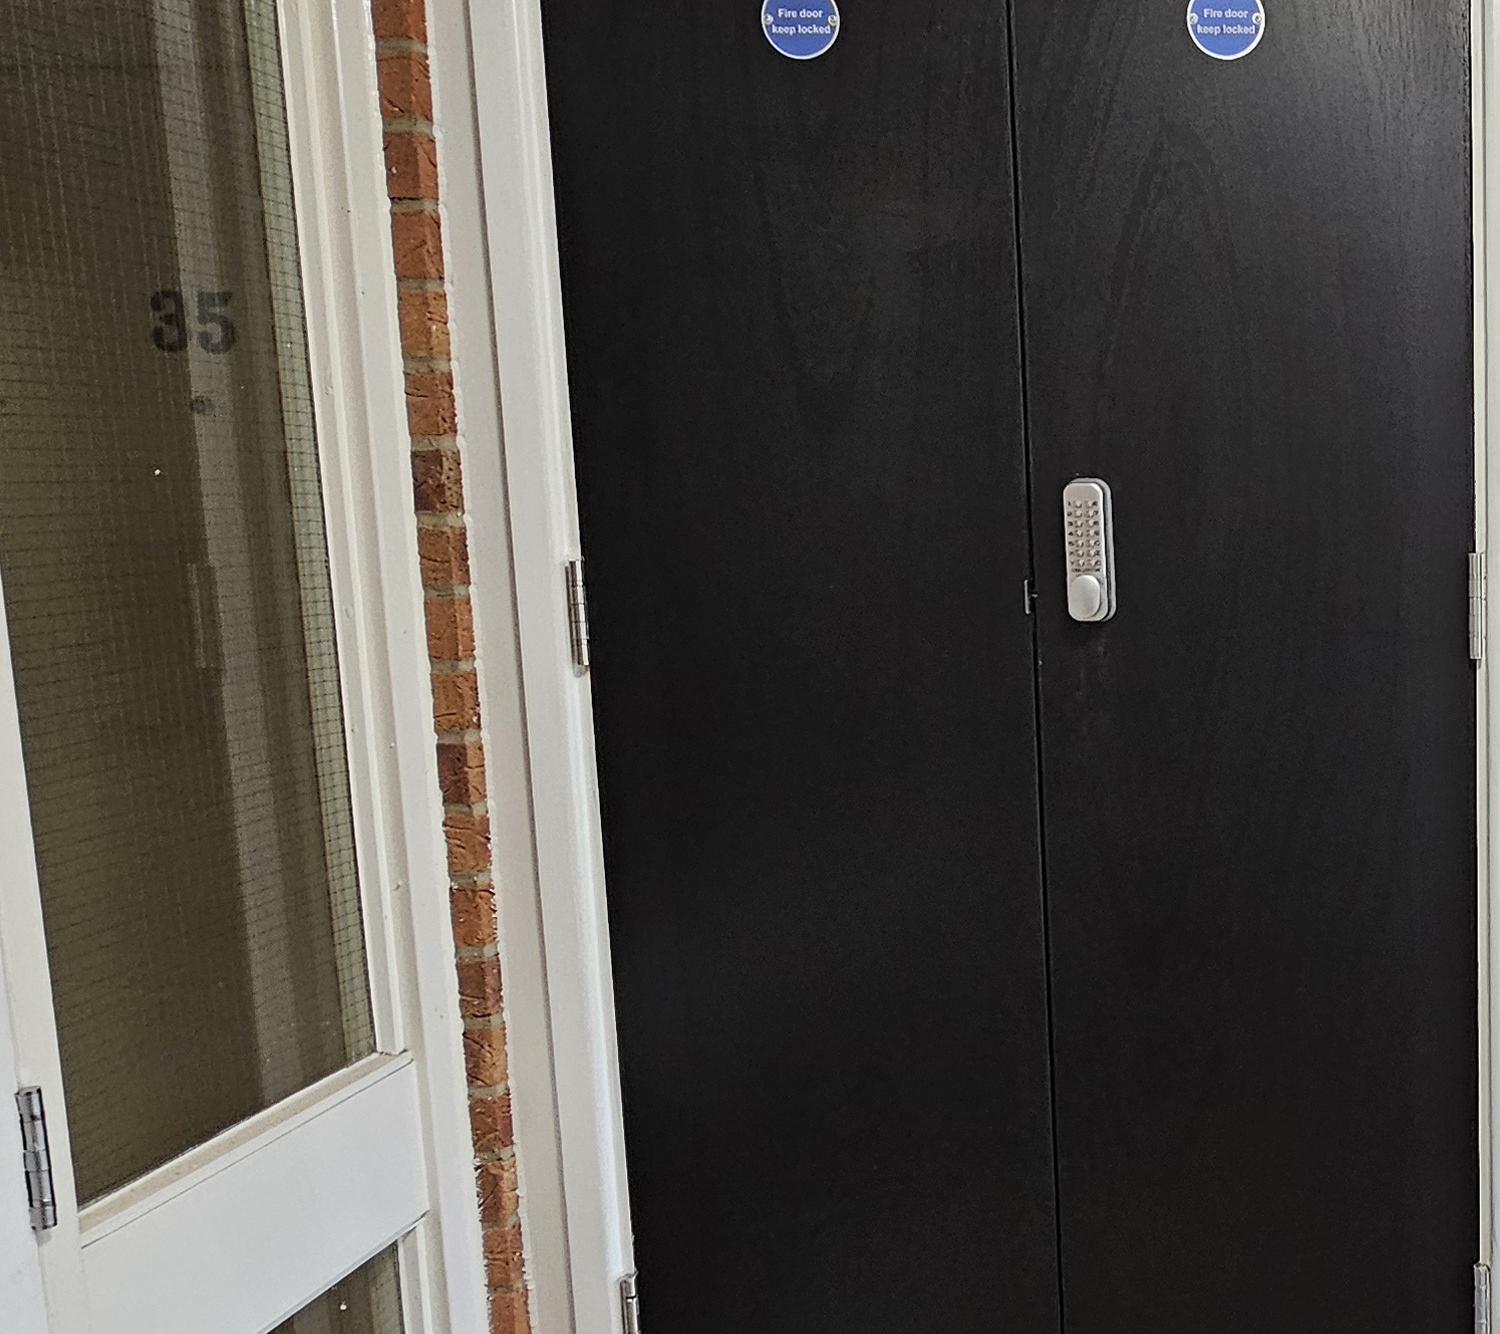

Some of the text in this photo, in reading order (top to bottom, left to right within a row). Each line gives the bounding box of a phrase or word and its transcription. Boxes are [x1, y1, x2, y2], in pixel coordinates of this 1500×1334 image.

[777, 8, 824, 19] Fire door
[1202, 8, 1249, 19] Fire door
[771, 24, 831, 36] keep locked
[1196, 24, 1256, 36] keep locked
[150, 289, 235, 356] 35
